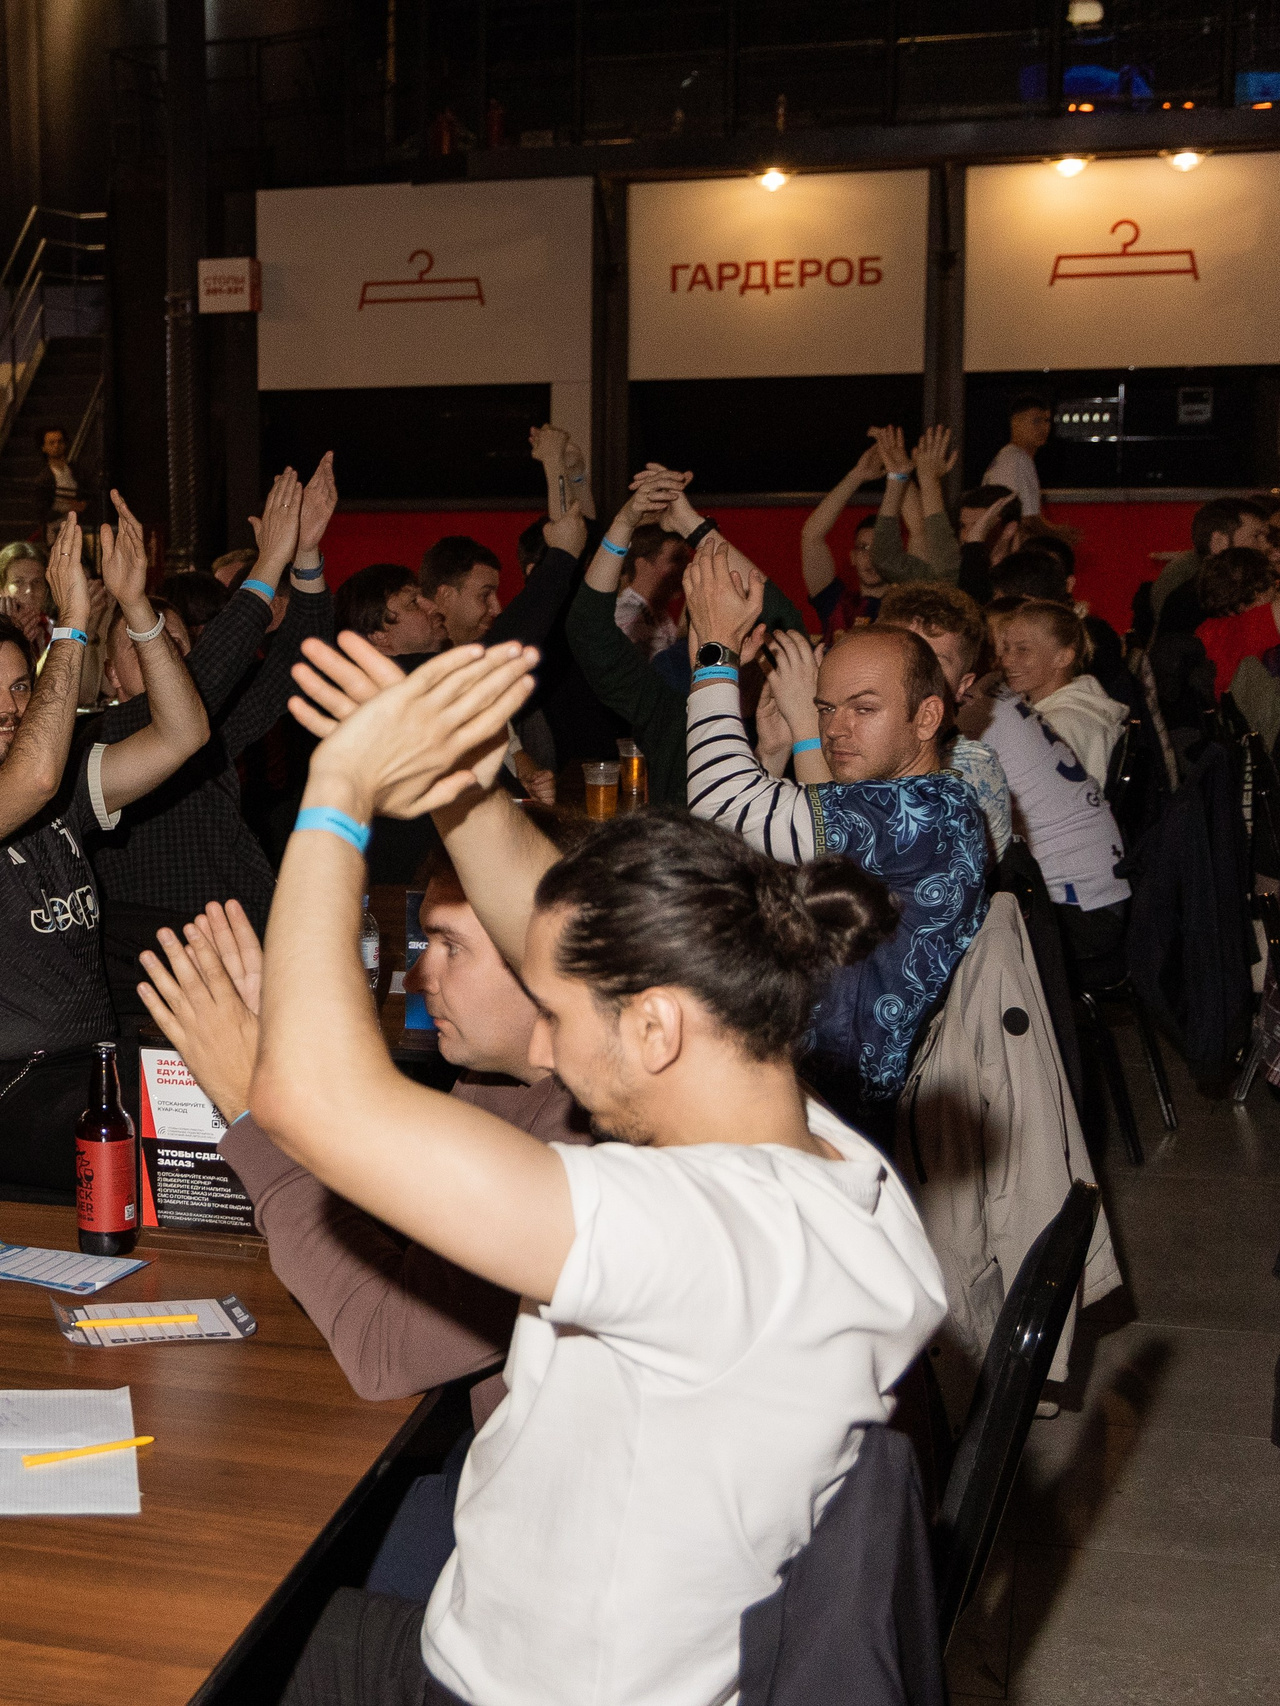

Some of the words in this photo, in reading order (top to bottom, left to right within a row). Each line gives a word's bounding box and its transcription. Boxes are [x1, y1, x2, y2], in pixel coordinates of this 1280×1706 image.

[671, 256, 882, 295] ГАРДЕРОБ
[157, 1059, 186, 1067] ЗАКА
[157, 1100, 205, 1108] ОТСКАНИРУЙТЕ
[157, 1149, 194, 1158] ЧТОБЫ
[195, 1152, 225, 1161] СДЕЛ
[157, 1158, 195, 1168] ЗАКАЗ:
